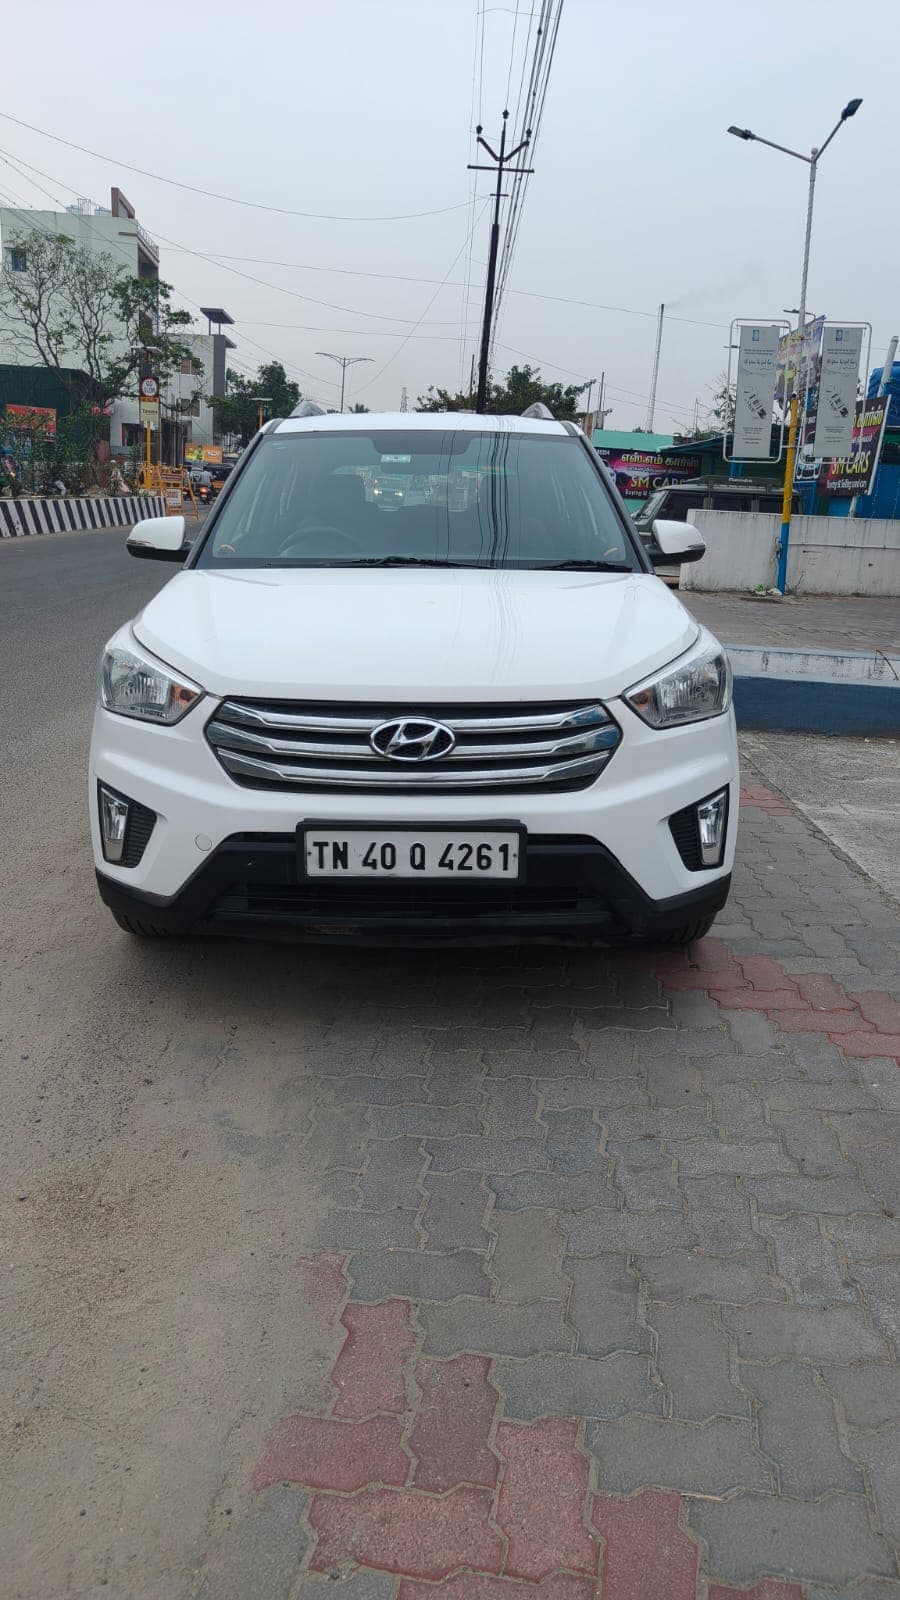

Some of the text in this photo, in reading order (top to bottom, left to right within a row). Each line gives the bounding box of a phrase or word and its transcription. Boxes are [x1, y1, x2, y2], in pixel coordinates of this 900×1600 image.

[621, 452, 663, 465] எஸ்.எம்
[846, 451, 871, 474] CARS
[630, 476, 649, 489] SM
[312, 841, 510, 871] TN 40 Q 4261
